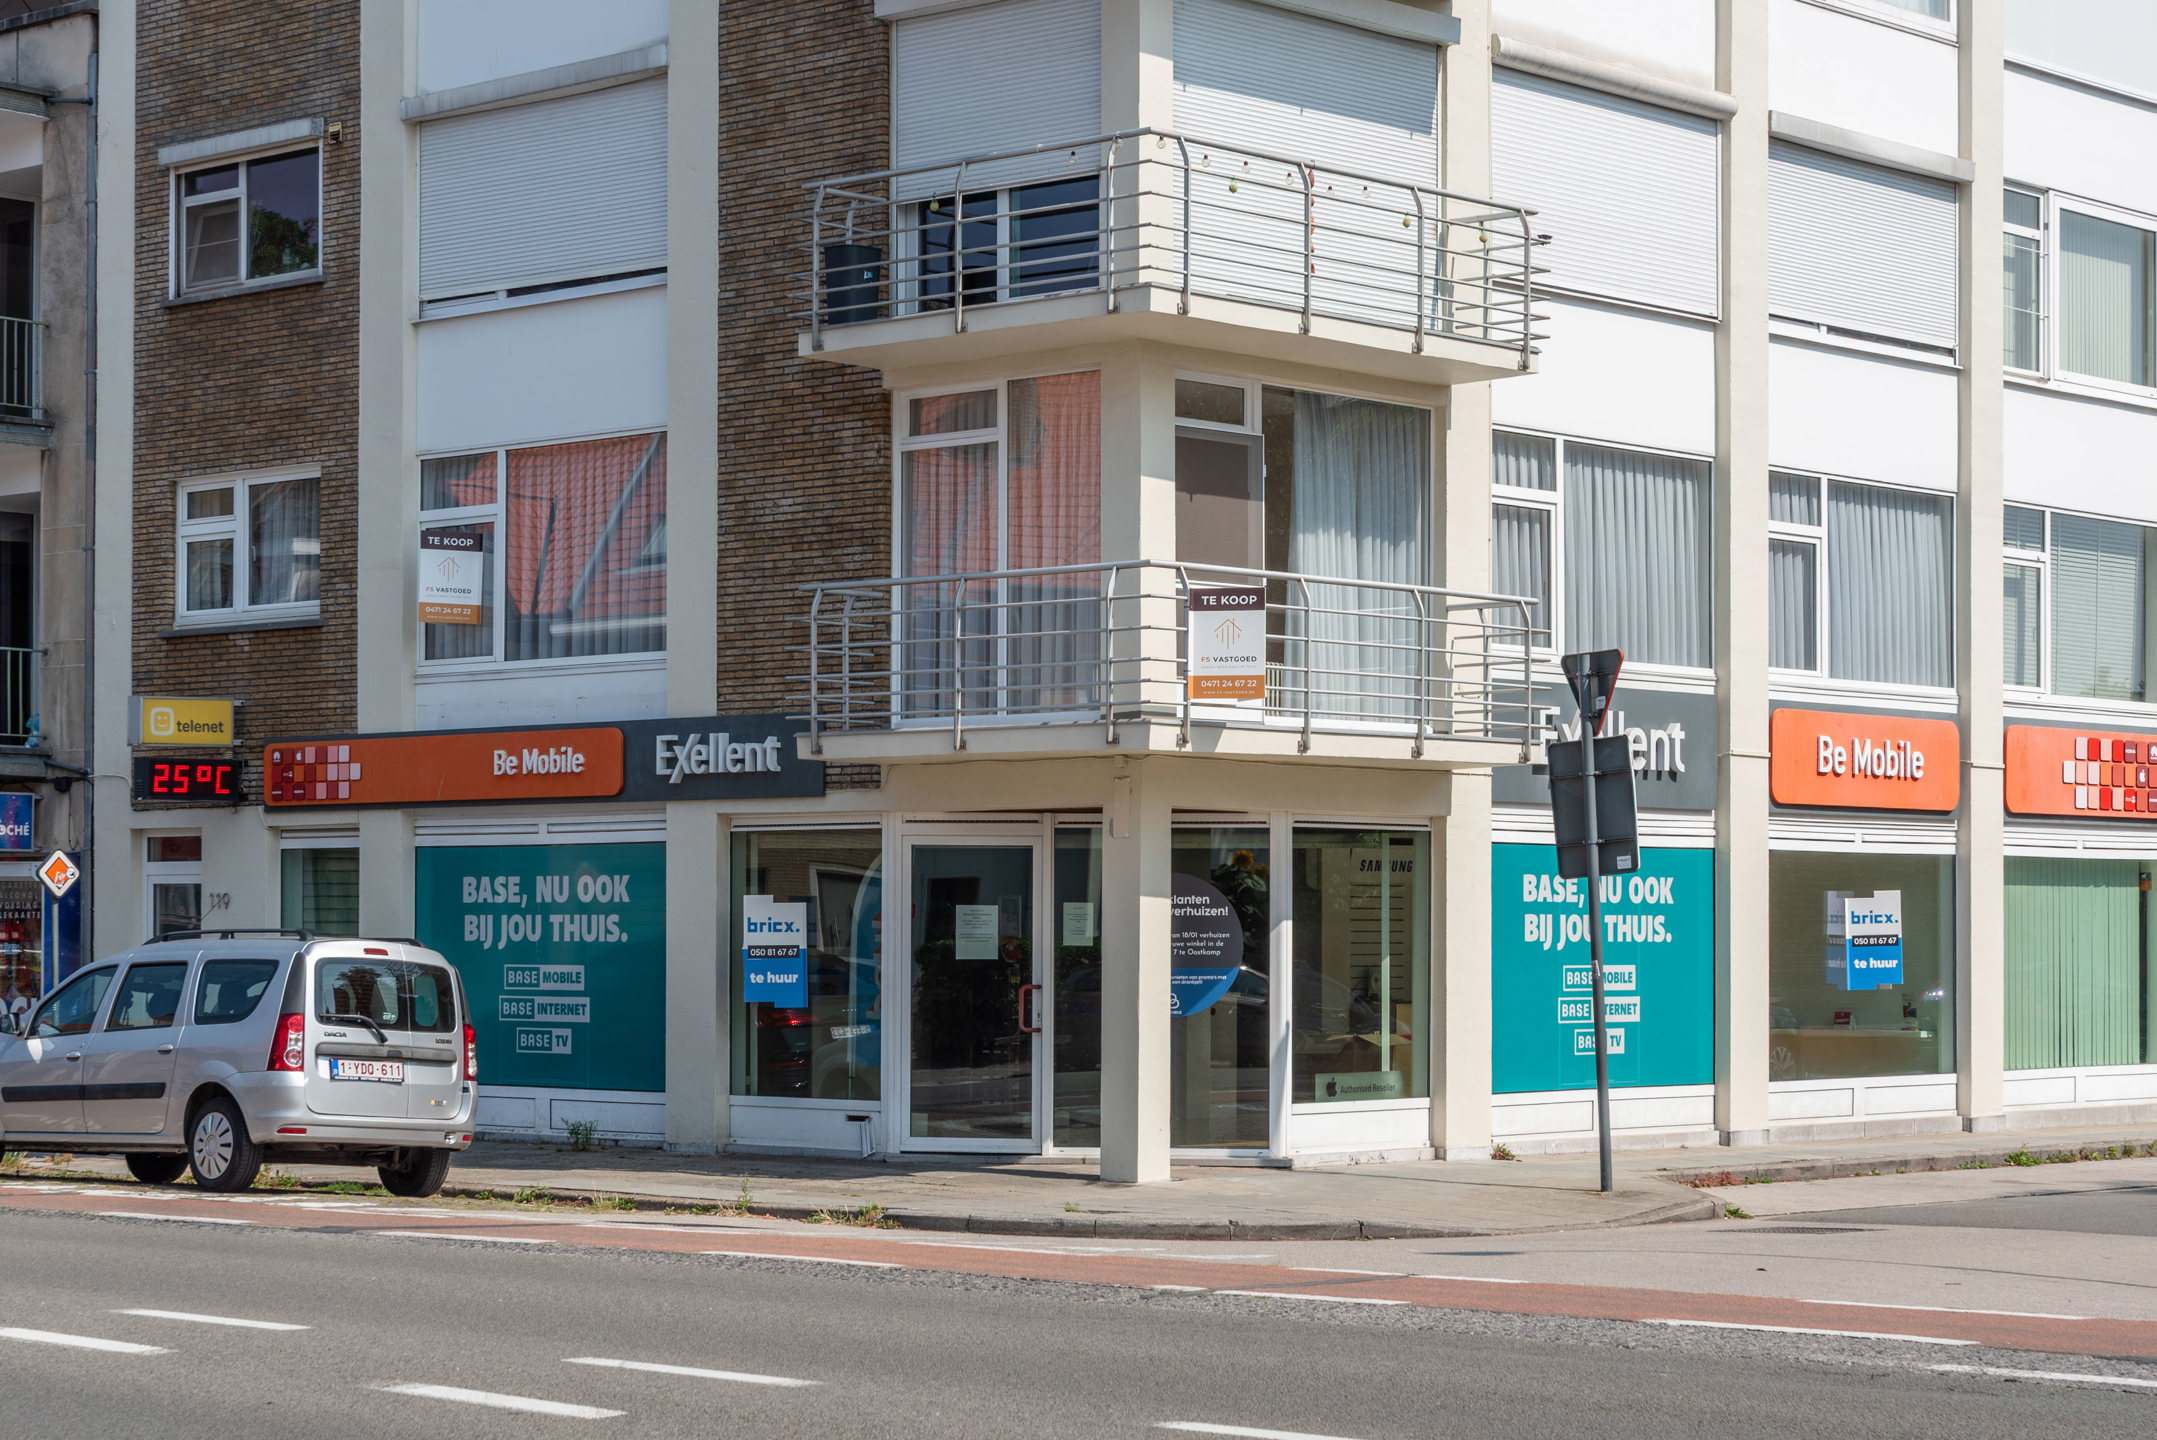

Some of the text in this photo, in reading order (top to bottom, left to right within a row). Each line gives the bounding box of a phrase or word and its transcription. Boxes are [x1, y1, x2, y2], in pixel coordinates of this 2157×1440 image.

[428, 537, 473, 546] TE KOOP
[1202, 596, 1257, 605] TE KOOP
[1201, 680, 1220, 688] 0471
[177, 720, 224, 733] telenet
[493, 746, 584, 776] Be Mobile
[1817, 735, 1924, 779] Be Mobile
[1360, 859, 1413, 872] SAMUNG
[462, 875, 630, 908] BASE, NU OOK
[1523, 874, 1584, 908] BASE,
[1629, 876, 1674, 904] OOK
[1171, 895, 1209, 904] lanten
[1851, 911, 1898, 924] bricx.
[748, 917, 800, 932] bricx.
[464, 914, 628, 950] BIJ JOU THUIS.
[1524, 914, 1552, 950] BIJ
[1604, 915, 1672, 942] THUIS.
[1854, 937, 1868, 945] 050
[1870, 937, 1877, 945] 81
[768, 948, 776, 956] 81
[778, 948, 787, 956] 67
[788, 948, 797, 956] 67
[1854, 958, 1867, 968] te
[1870, 958, 1898, 968] huur
[508, 971, 582, 984] BASE MOBILE
[750, 972, 798, 983] te huur
[503, 1002, 587, 1016] BASE INTERNET
[1562, 1004, 1637, 1016] BASE TERNET
[520, 1034, 568, 1047] BASE TV
[1610, 1035, 1621, 1047] TV
[1340, 1084, 1396, 1093] Authorised Reseller
